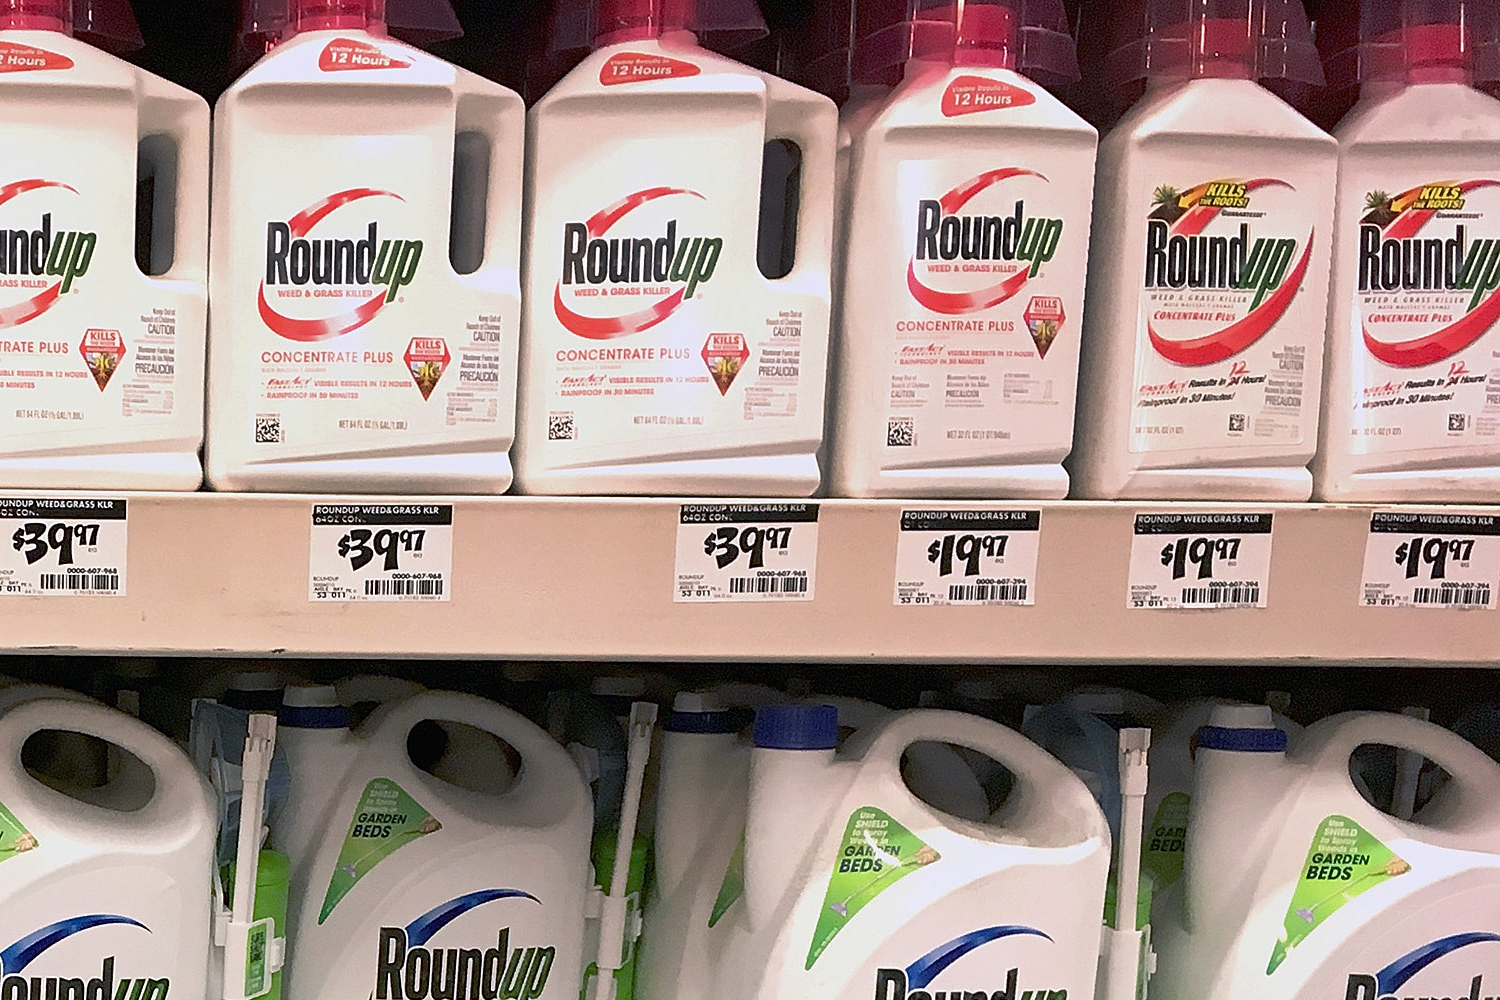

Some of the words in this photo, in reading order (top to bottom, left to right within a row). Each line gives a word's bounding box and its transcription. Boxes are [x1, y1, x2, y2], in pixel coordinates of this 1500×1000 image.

[8, 54, 46, 67] Hours
[954, 93, 970, 105] 12
[974, 93, 1011, 107] Hours
[1206, 184, 1245, 198] KILLS
[918, 201, 1062, 278] Roundup
[267, 222, 423, 302] Roundup
[563, 221, 722, 299] Roundup
[1146, 223, 1295, 310] Roundup
[148, 324, 175, 335] CAUTION
[896, 321, 983, 332] CONCENTRATE
[988, 320, 1014, 332] PLUS
[90, 332, 116, 340] KILLS
[40, 342, 69, 353] PLUS
[35, 501, 93, 510] WEED&GRASS
[1312, 853, 1370, 867] GARDEN
[1307, 866, 1352, 881] BEDS
